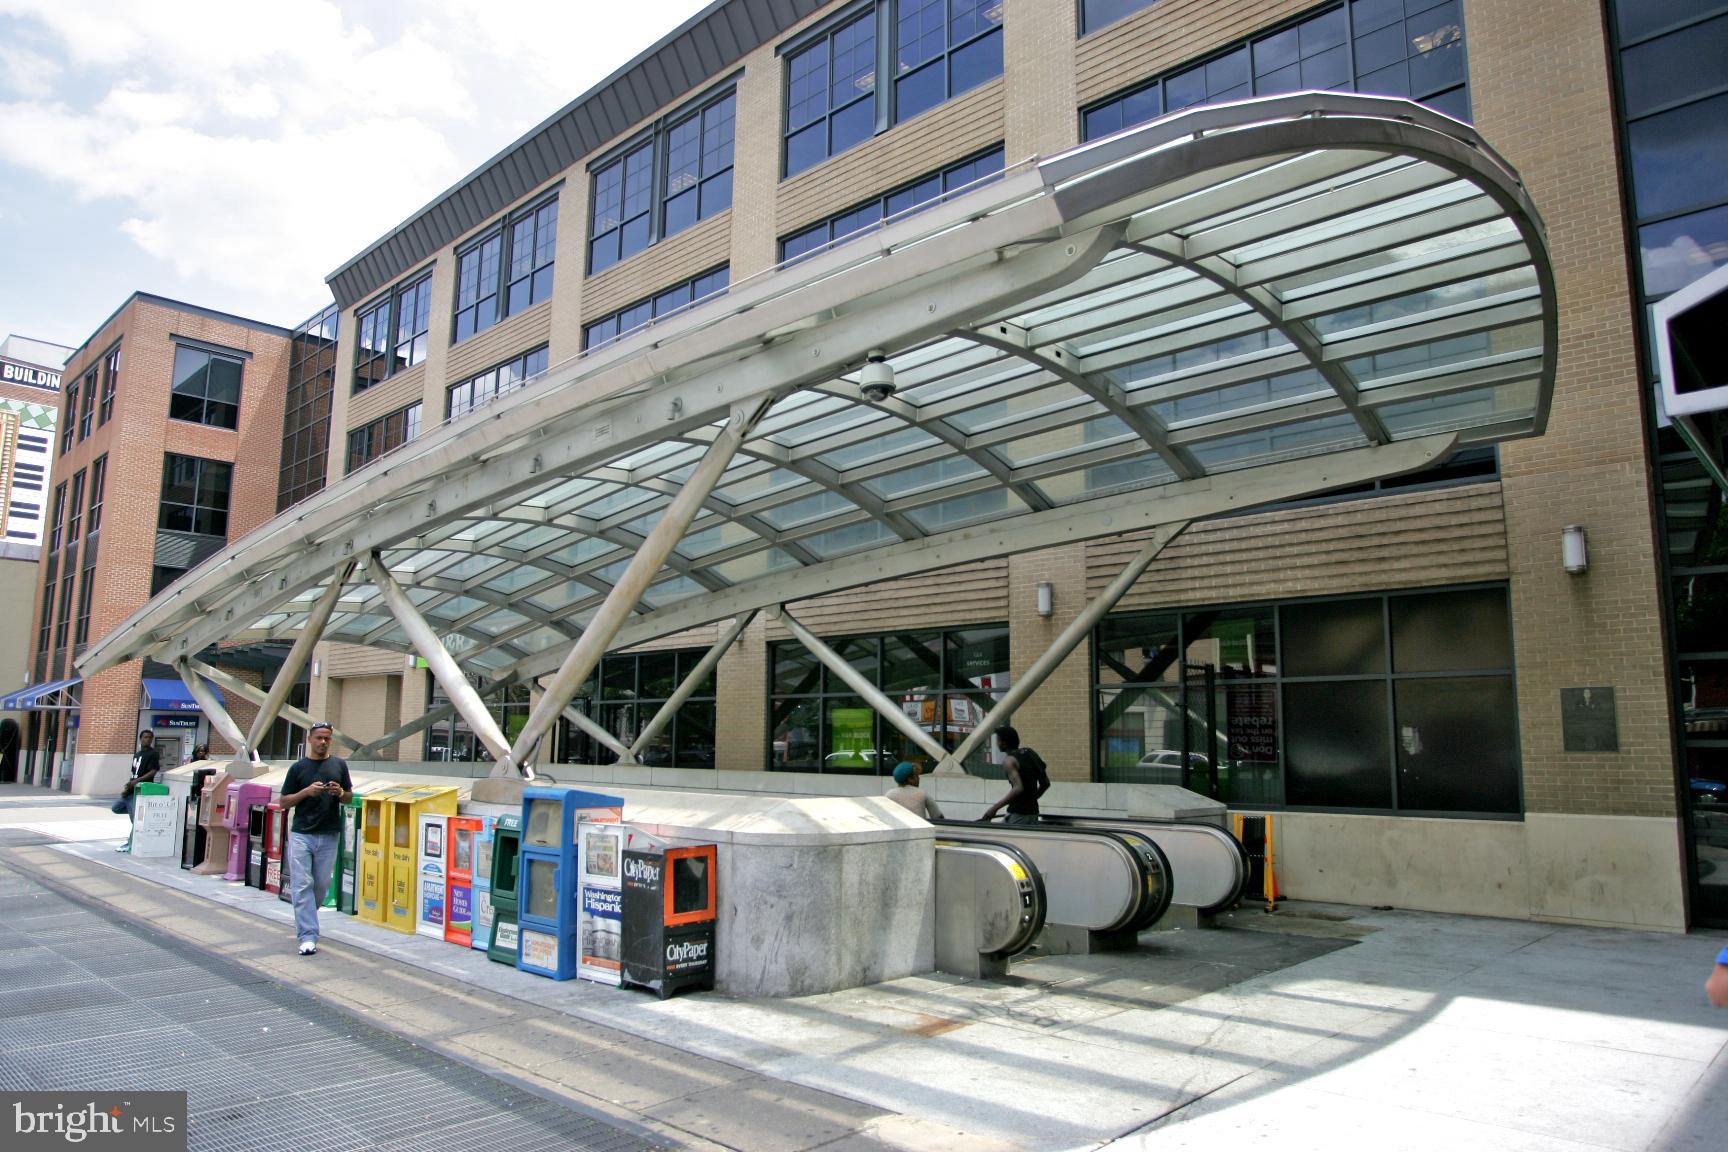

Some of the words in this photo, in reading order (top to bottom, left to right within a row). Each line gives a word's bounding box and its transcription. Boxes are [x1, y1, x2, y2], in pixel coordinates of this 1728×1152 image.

[1231, 716, 1273, 728] rebate
[504, 819, 519, 829] FREE
[666, 942, 708, 962] CityPaper
